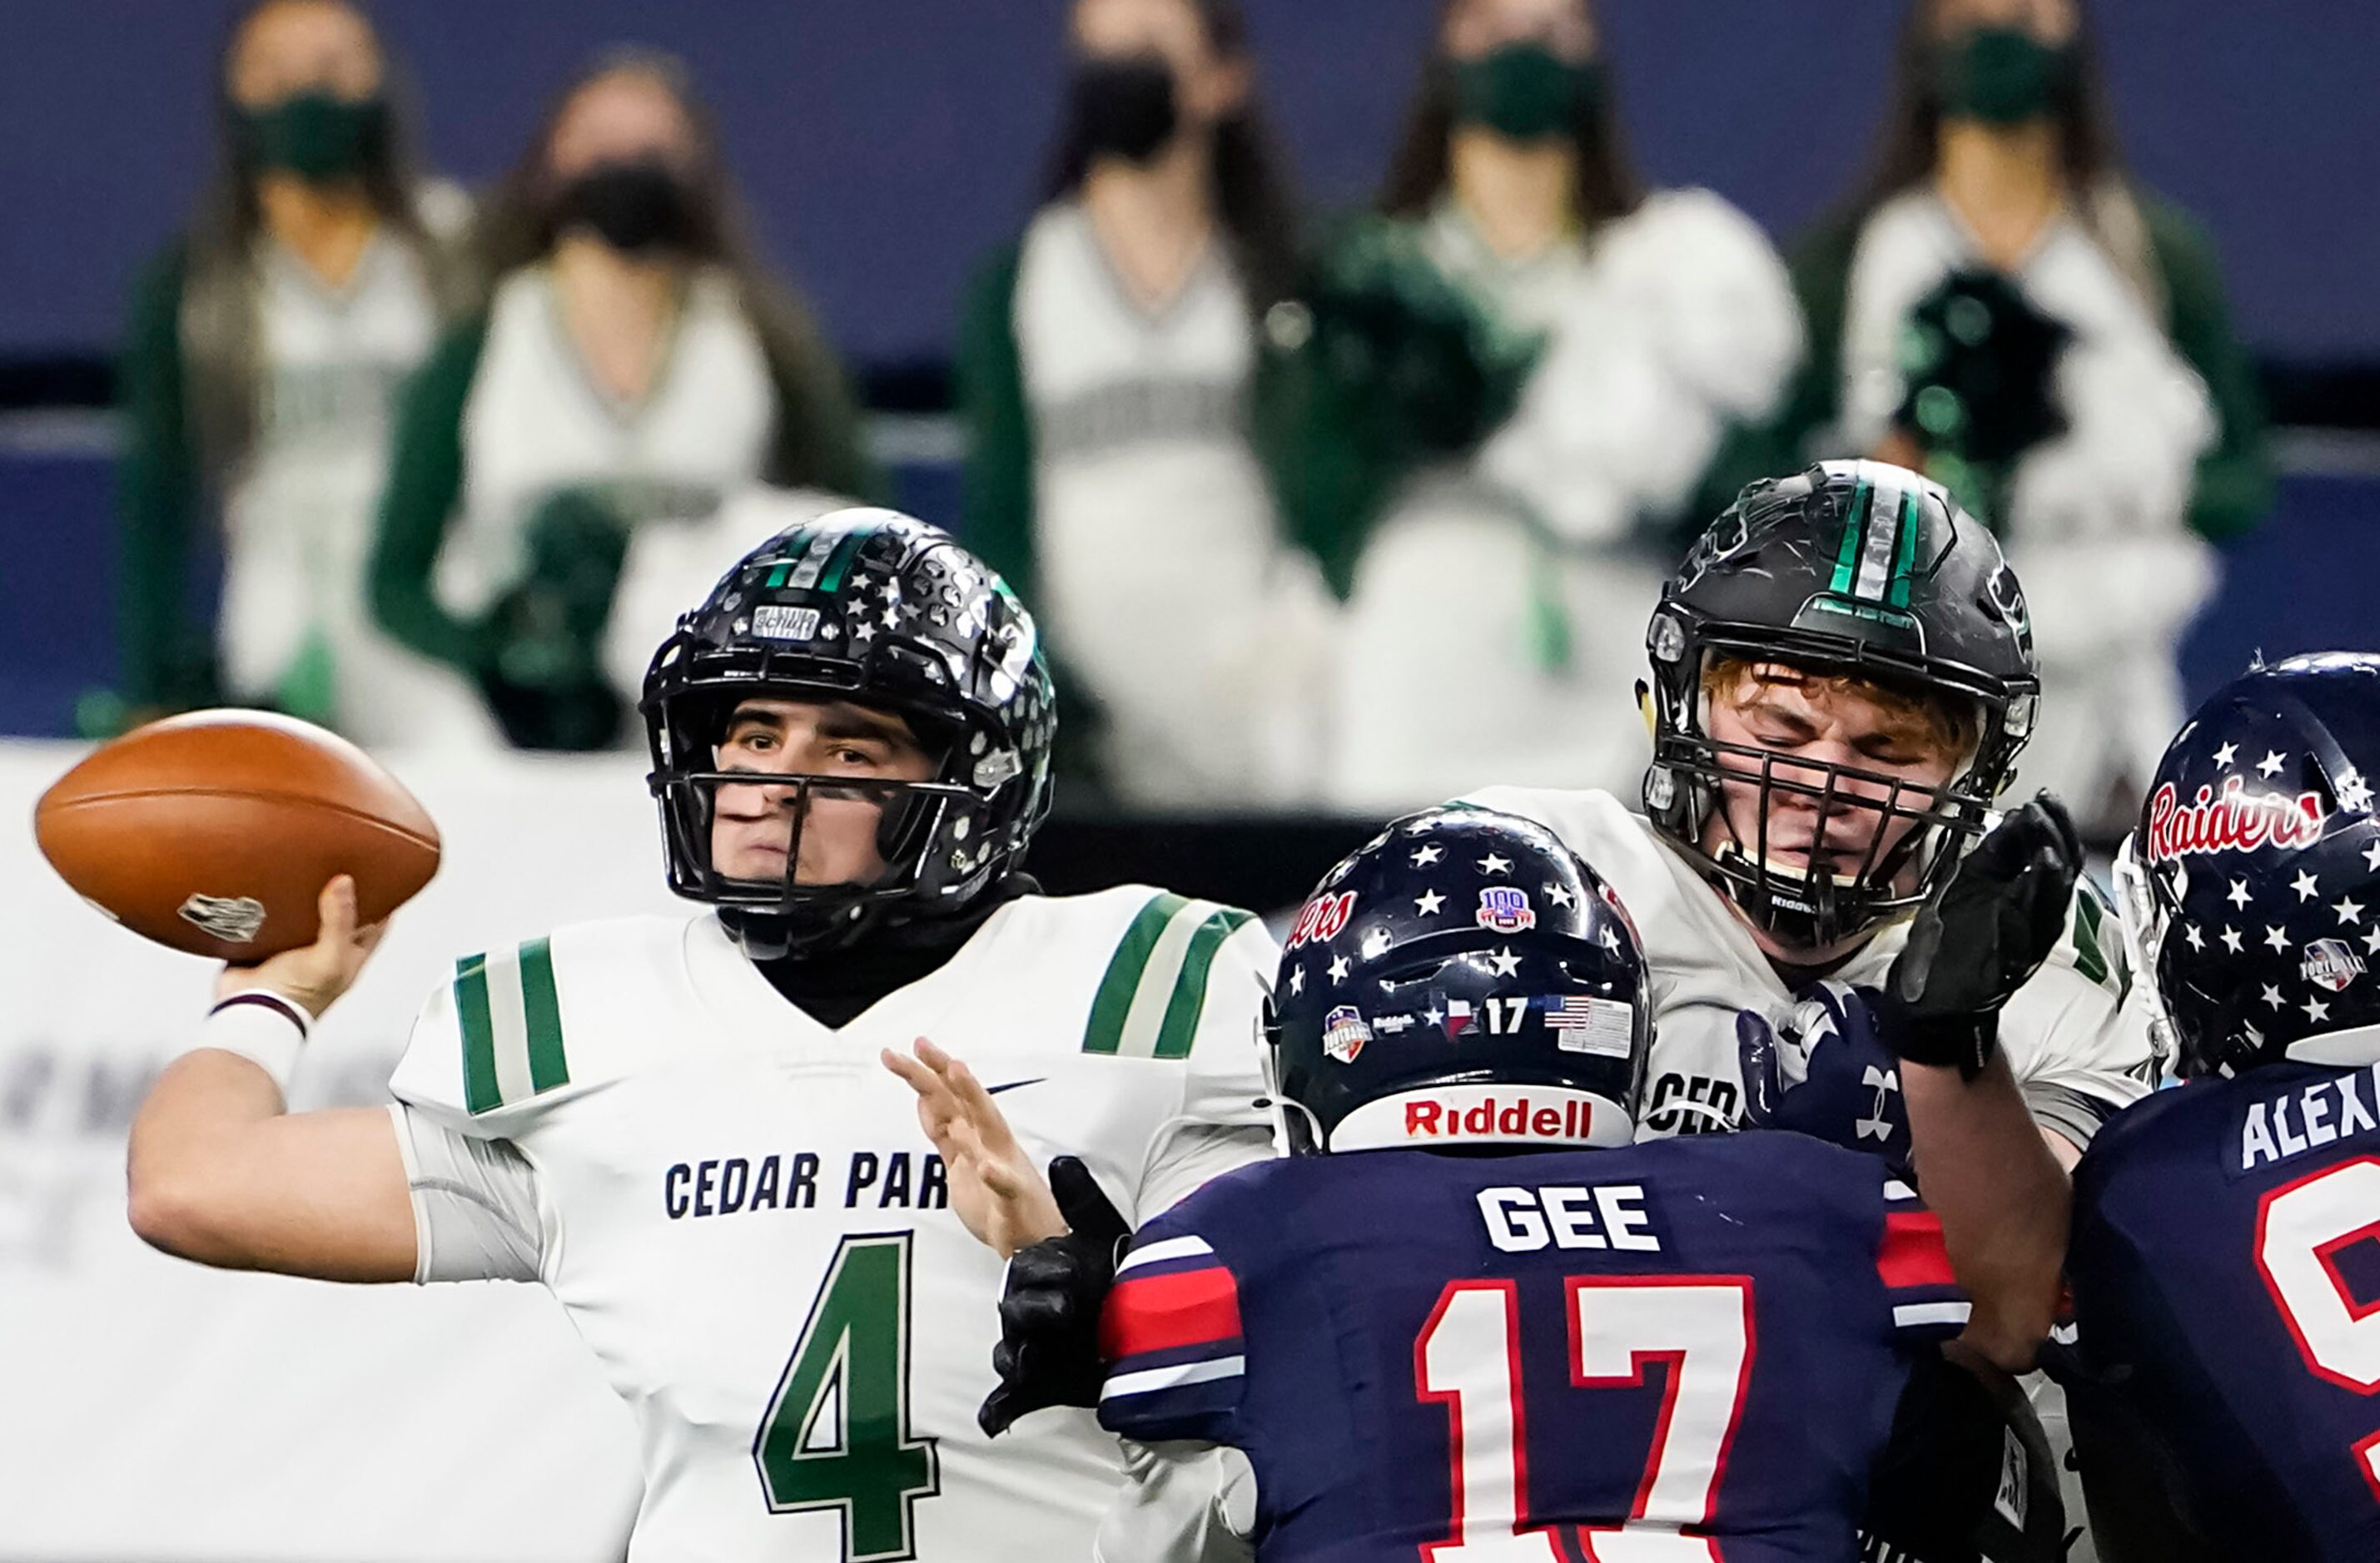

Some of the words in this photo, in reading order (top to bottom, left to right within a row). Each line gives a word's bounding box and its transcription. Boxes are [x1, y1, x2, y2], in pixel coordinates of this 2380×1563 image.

[2149, 774, 2323, 868] Raiders
[1485, 890, 1523, 909] 100
[1486, 997, 1528, 1035] 17
[1405, 1098, 1592, 1139] Riddell
[665, 1153, 820, 1220] CEDAR
[844, 1152, 949, 1210] PAR
[1476, 1185, 1662, 1253] GEE
[752, 1229, 941, 1563] 4
[1414, 1274, 1758, 1563] 17
